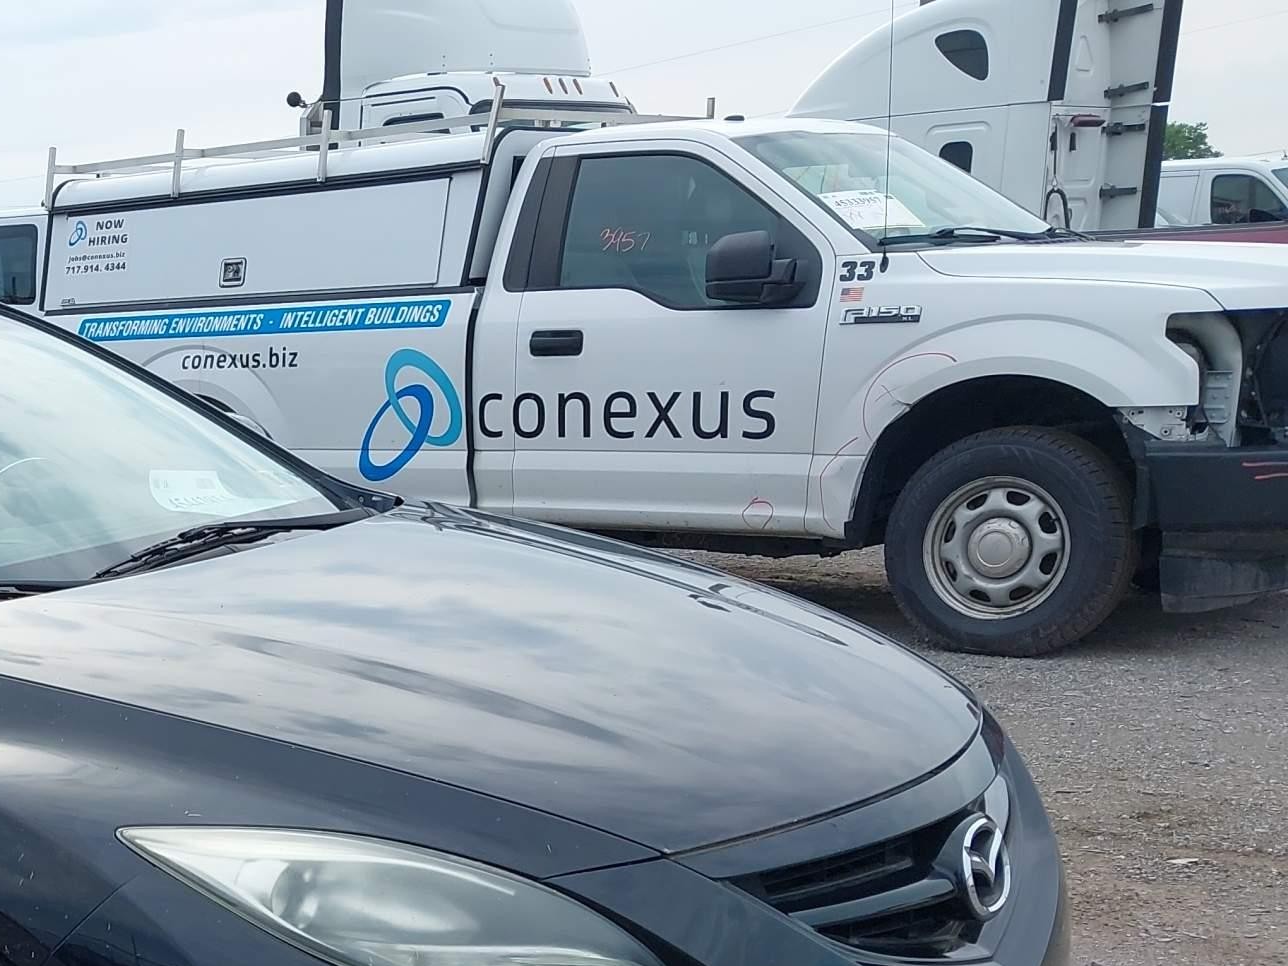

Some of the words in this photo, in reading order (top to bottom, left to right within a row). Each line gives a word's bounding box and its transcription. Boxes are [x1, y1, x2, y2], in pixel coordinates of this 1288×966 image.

[96, 219, 124, 231] NOW
[88, 233, 128, 247] HIRING
[839, 260, 876, 282] 33
[83, 318, 169, 338] TRANSFORMING
[169, 313, 264, 334] ENVIRONMENTS
[279, 308, 365, 329] INTELLIGENT
[364, 304, 443, 325] BUILDINGS
[181, 346, 299, 370] conexus.biz
[478, 389, 776, 440] conexus
